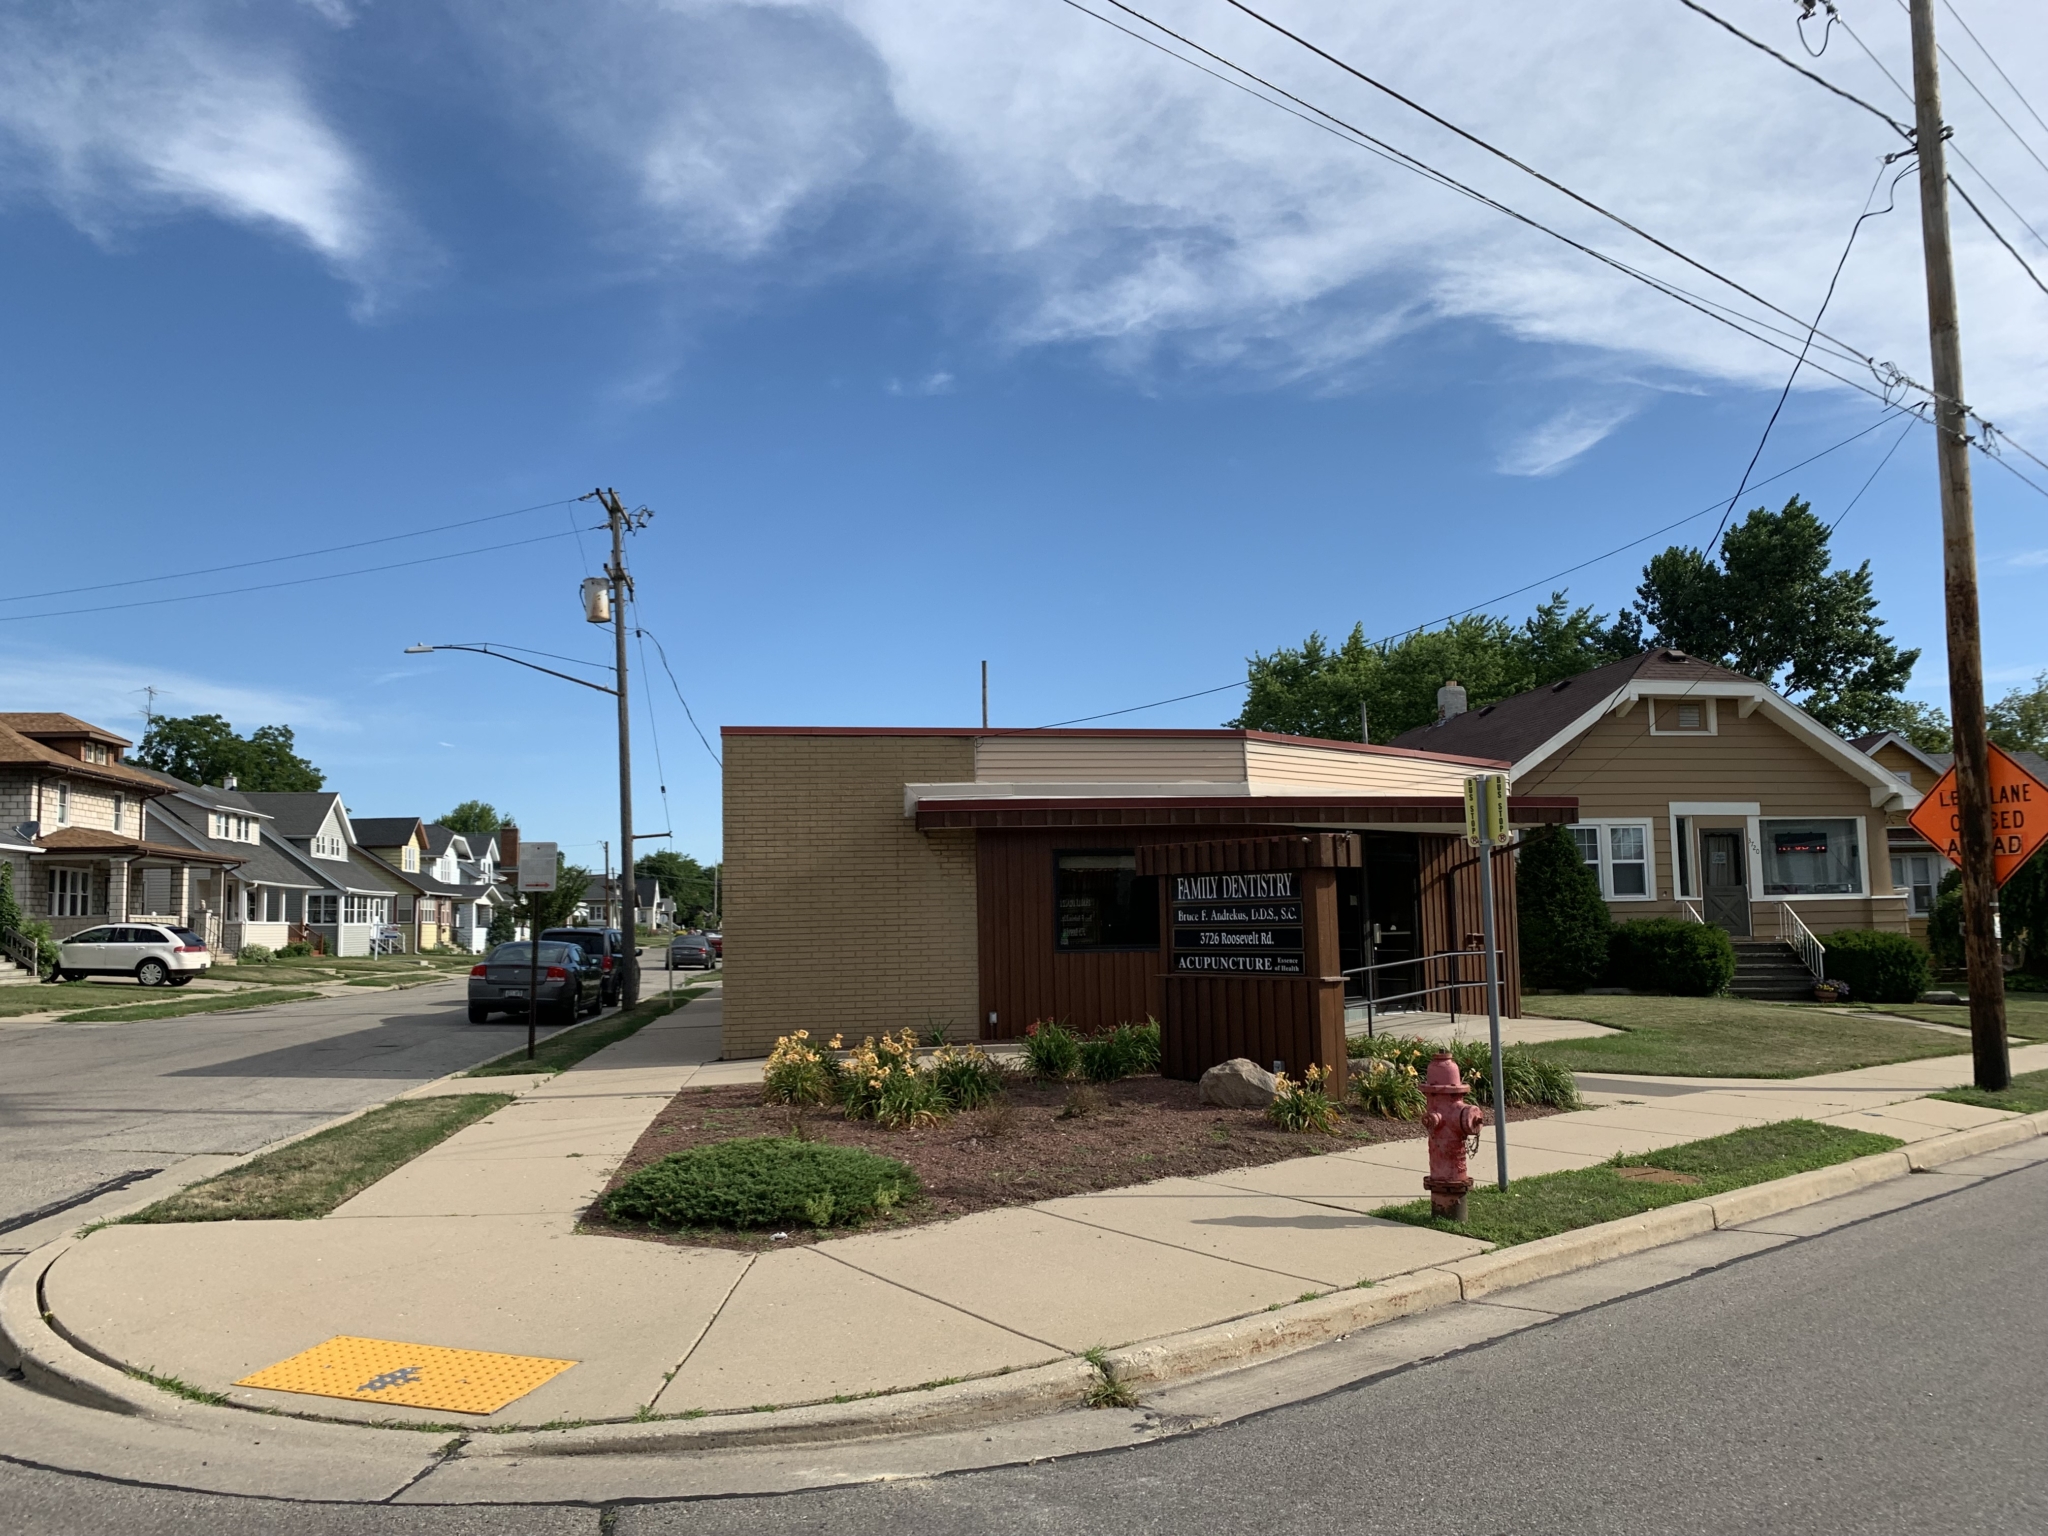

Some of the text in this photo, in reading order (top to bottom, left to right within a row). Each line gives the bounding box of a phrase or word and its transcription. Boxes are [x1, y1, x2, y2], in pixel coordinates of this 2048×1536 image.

[1989, 783, 2032, 804] LANE
[1950, 810, 2024, 832] CSED
[1946, 835, 2022, 857] AAD
[1177, 872, 1292, 900] FAMILY DENTISTRY
[1178, 910, 1199, 922] Bruce
[1201, 909, 1208, 921] F.
[1280, 906, 1297, 920] S.C.
[1200, 931, 1275, 945] 3726 Roosevelt Rd.
[1178, 956, 1273, 971] ACUPUNCTURE
